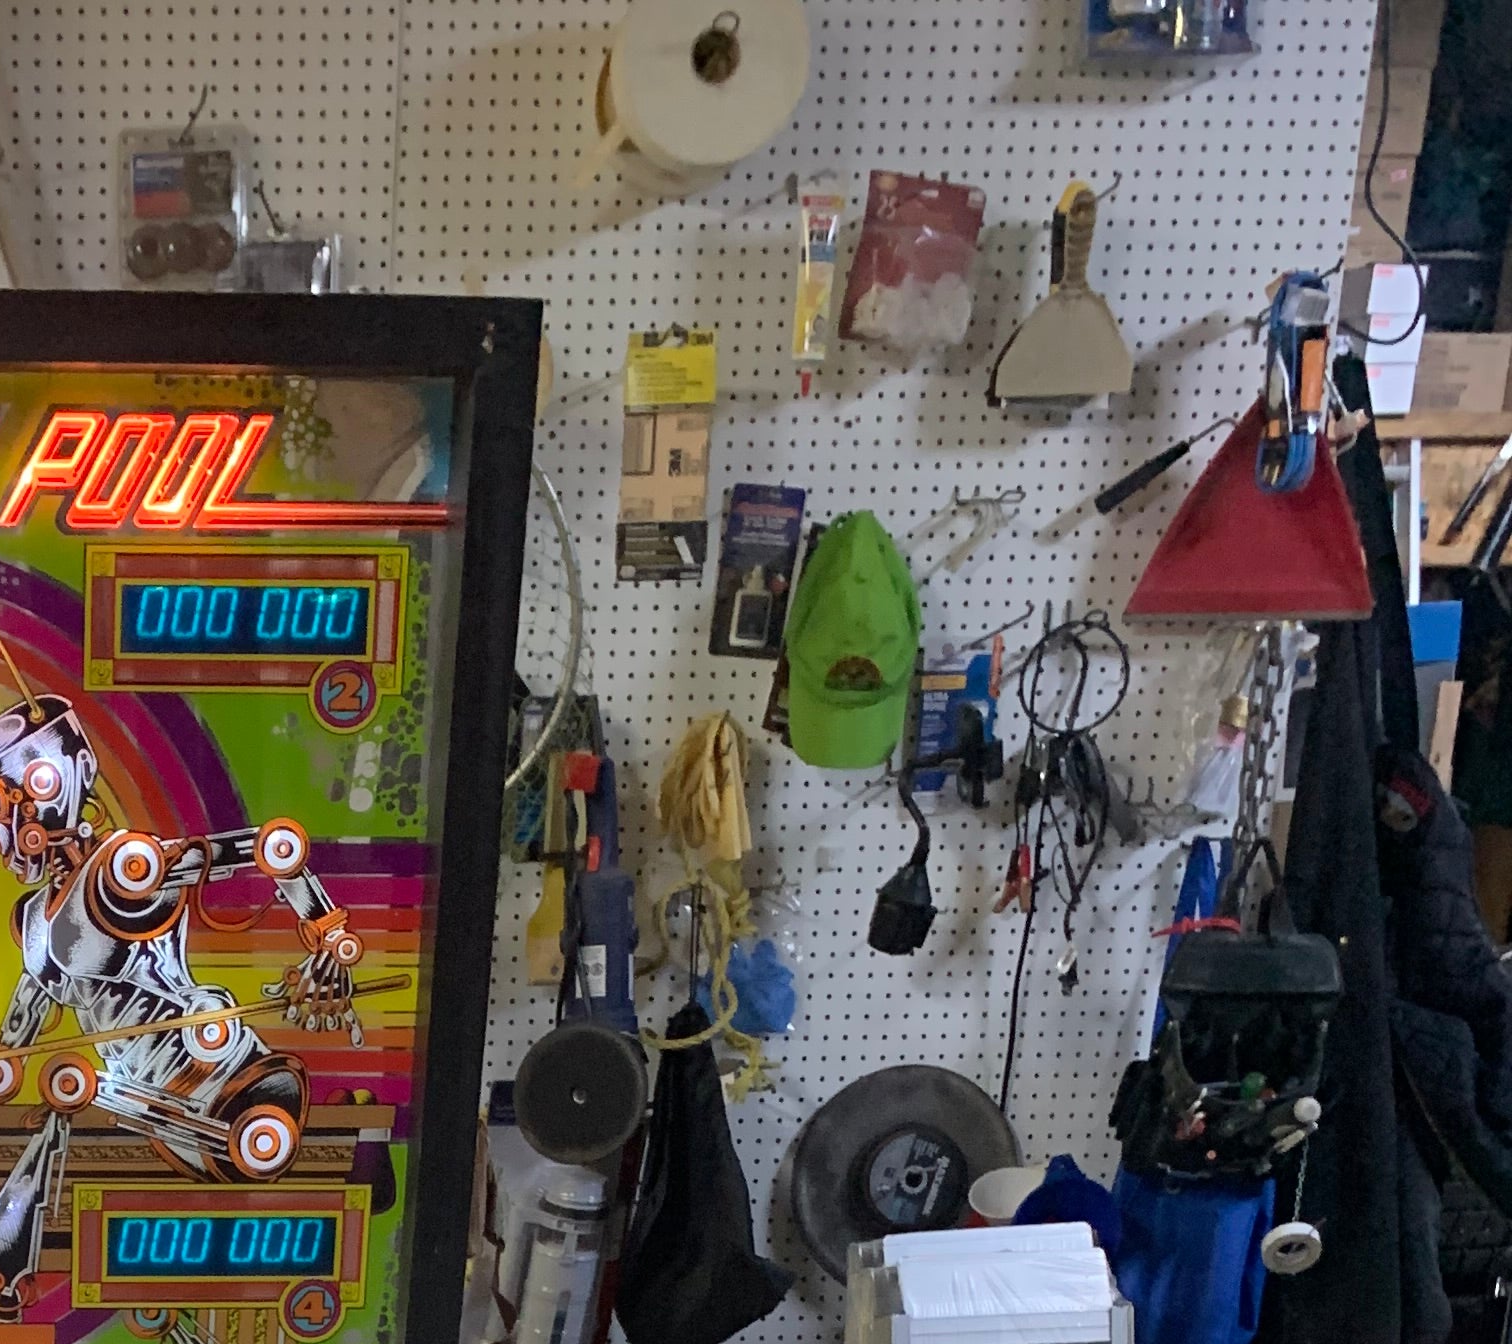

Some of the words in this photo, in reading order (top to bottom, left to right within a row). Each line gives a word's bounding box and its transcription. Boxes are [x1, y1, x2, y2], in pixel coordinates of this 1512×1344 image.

[135, 585, 240, 640] 000
[256, 586, 359, 640] 000
[326, 670, 365, 712] 2
[117, 1218, 213, 1264] 000
[228, 1218, 324, 1264] 000
[292, 1290, 333, 1326] 4
